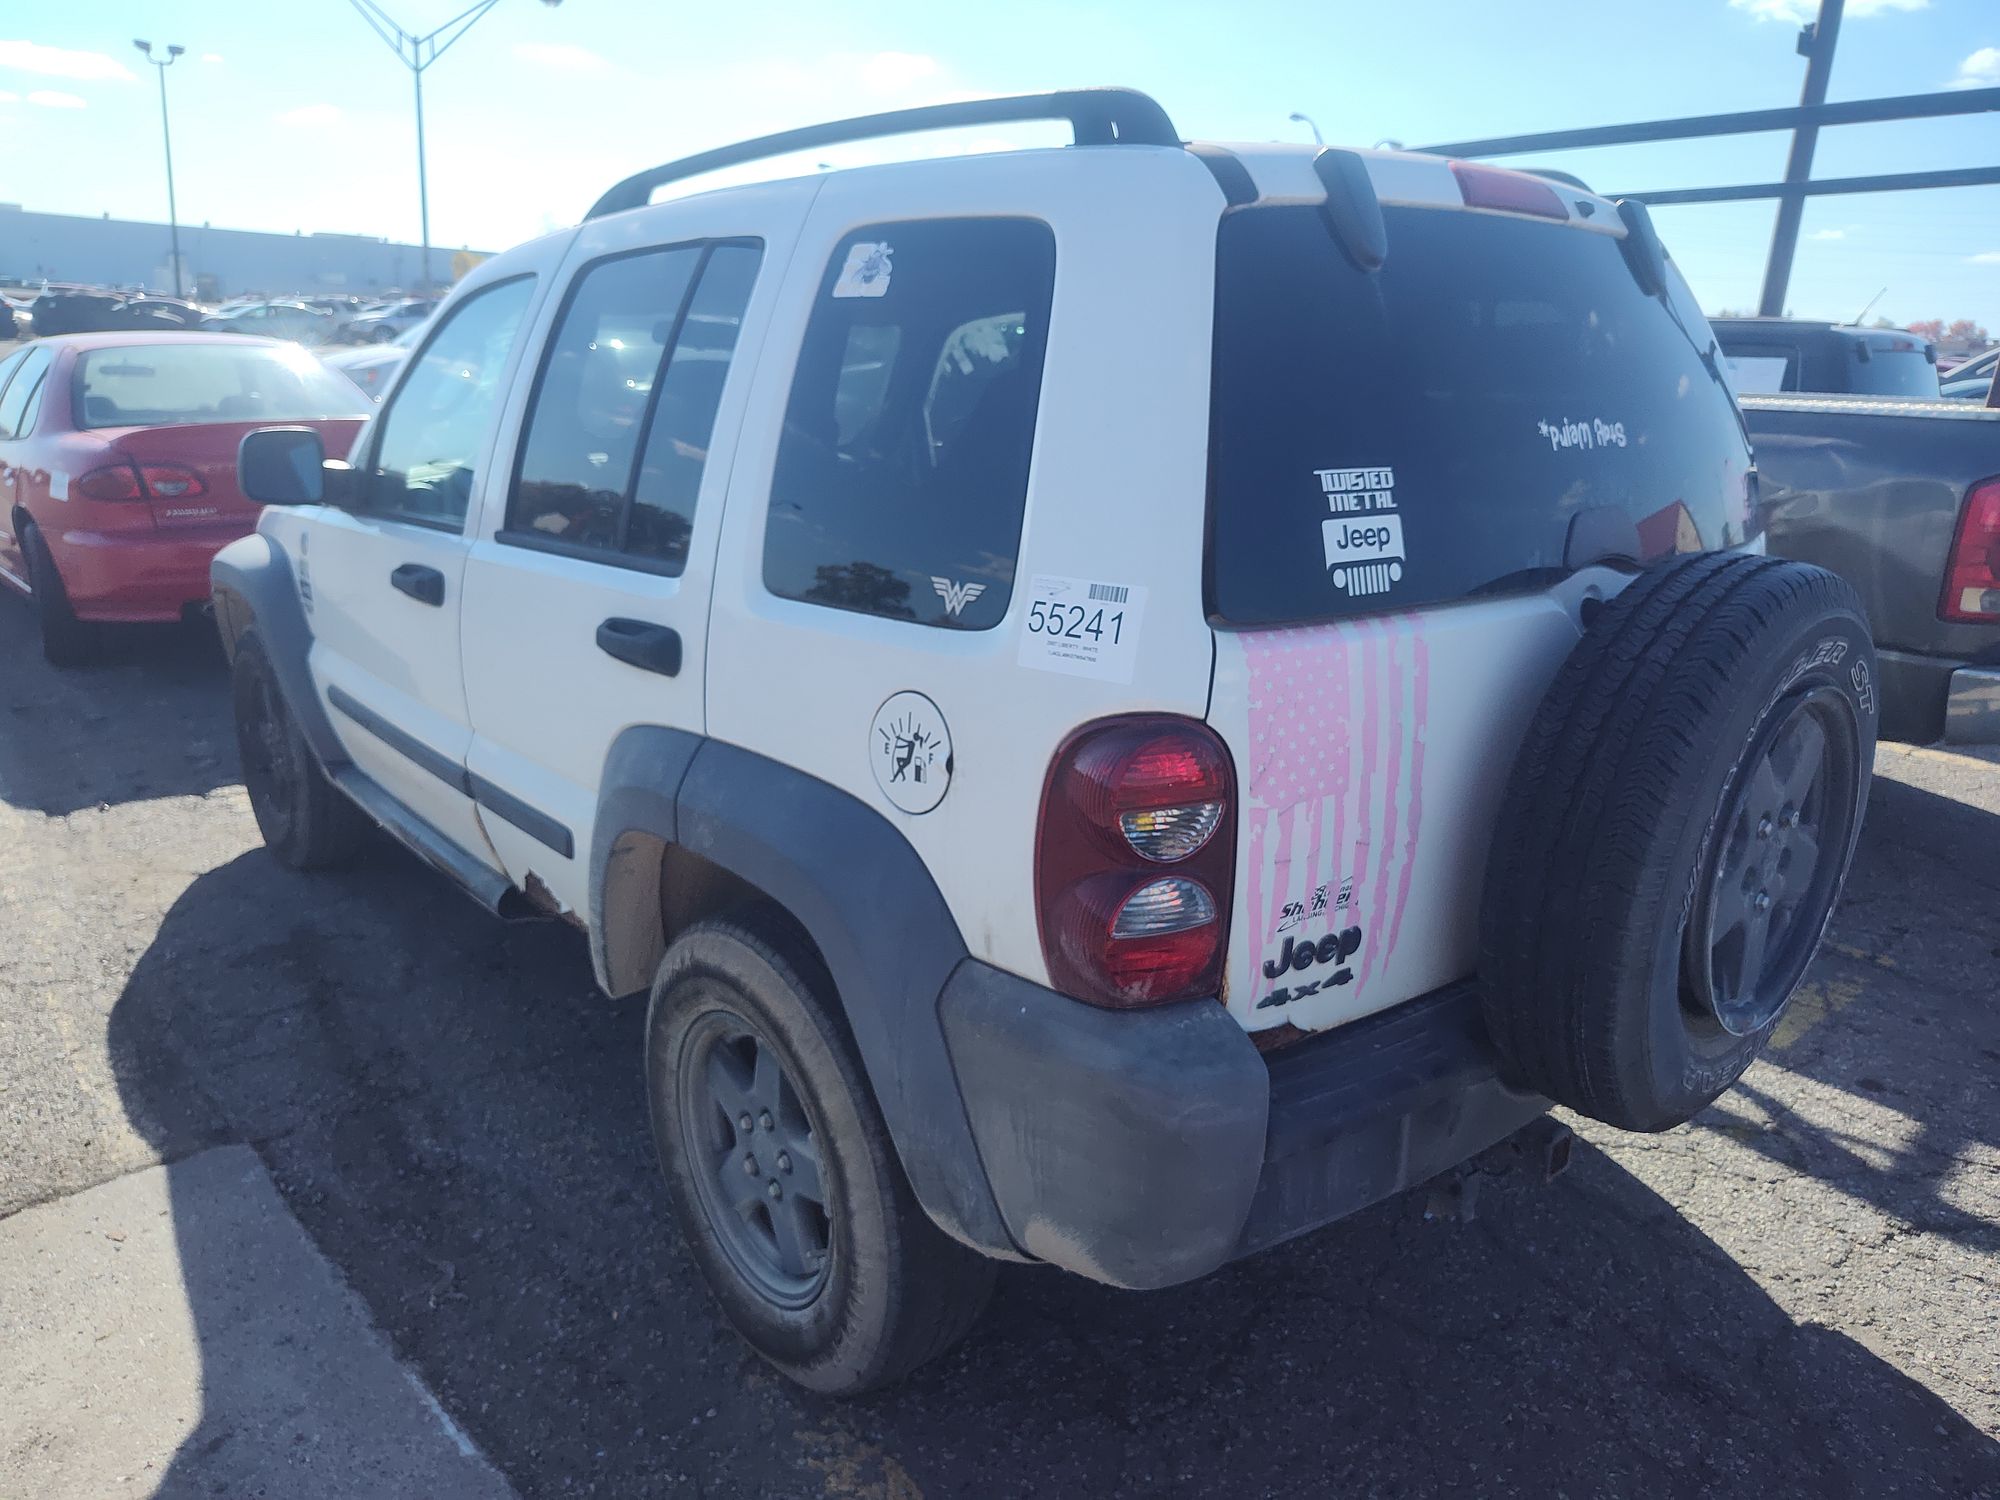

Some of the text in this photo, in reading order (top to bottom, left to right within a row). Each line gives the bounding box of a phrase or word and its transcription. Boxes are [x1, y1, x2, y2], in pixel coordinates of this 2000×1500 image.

[1336, 524, 1391, 552] Jeep
[1028, 600, 1123, 645] 55241
[1850, 660, 1875, 714] ST
[884, 742, 890, 755] E
[928, 752, 934, 765] F
[1262, 925, 1362, 979] Jeep
[1255, 967, 1354, 1010] 4x4
